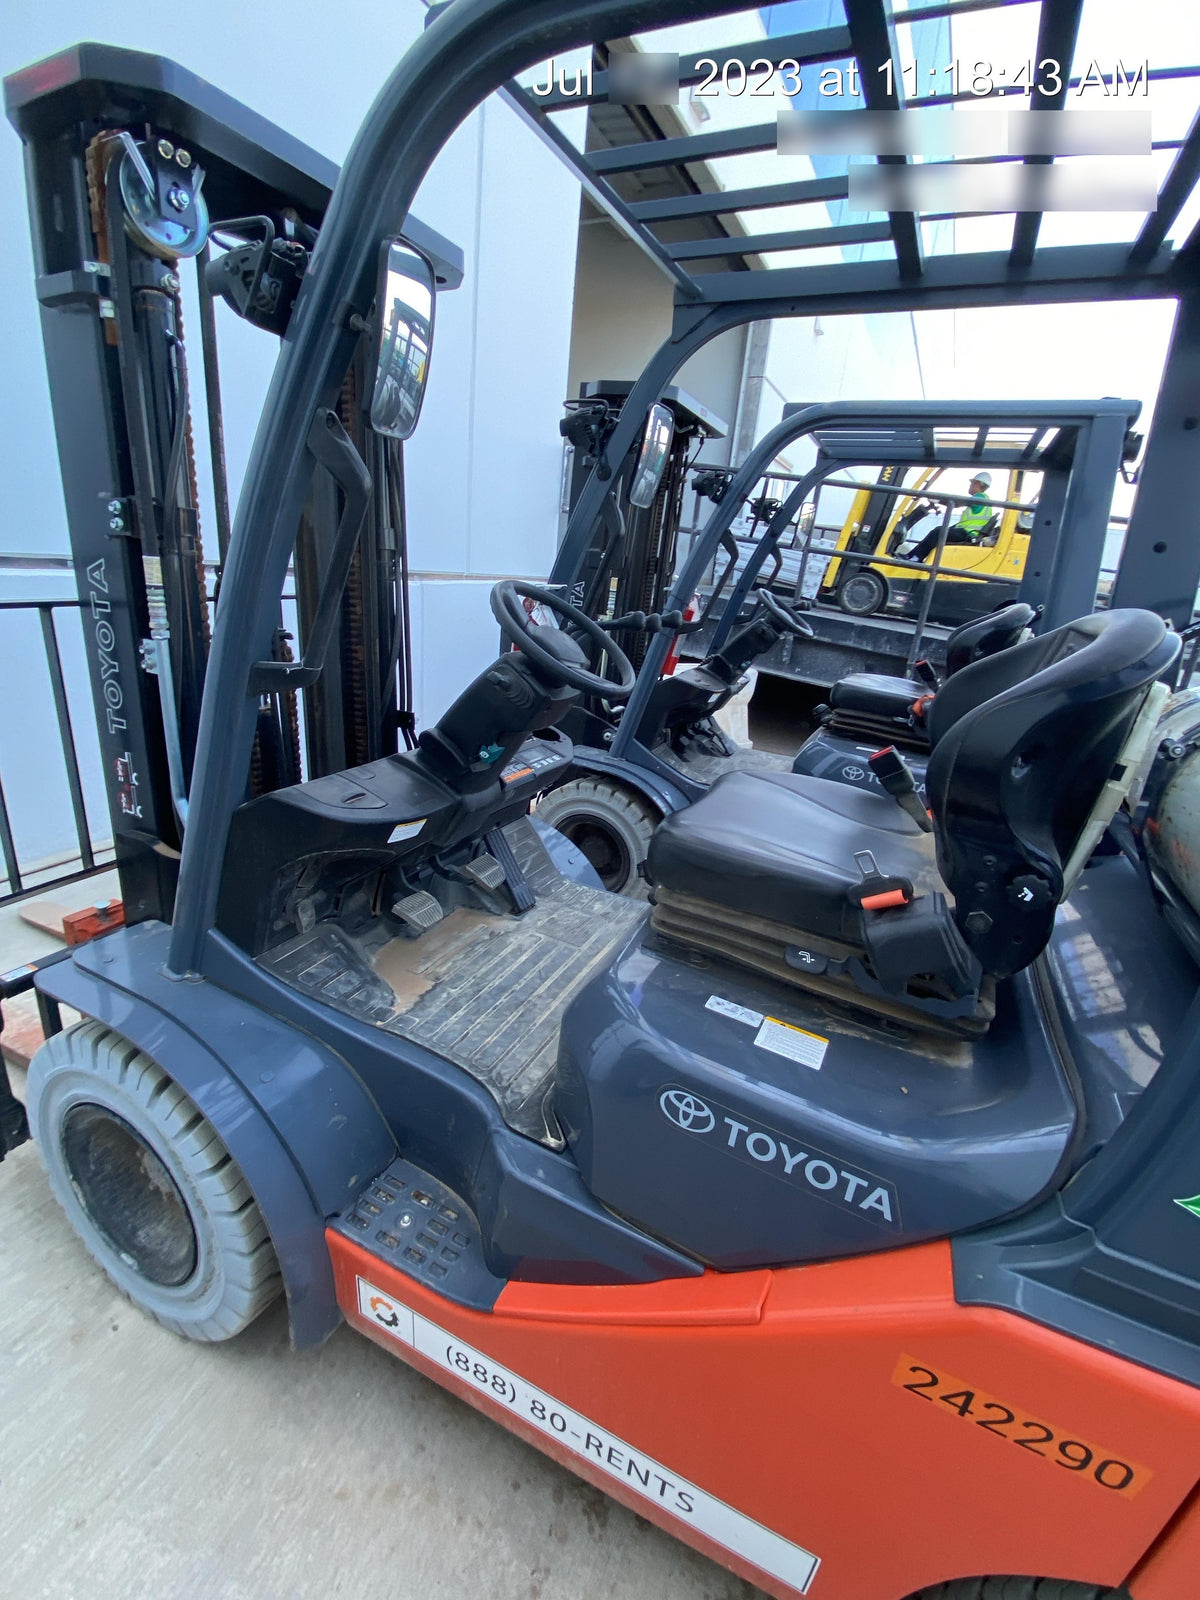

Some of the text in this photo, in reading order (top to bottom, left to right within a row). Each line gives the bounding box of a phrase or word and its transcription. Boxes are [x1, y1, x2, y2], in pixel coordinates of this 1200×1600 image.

[86, 557, 128, 735] TOYOTA
[723, 1116, 893, 1223] TOYOTA
[445, 1345, 696, 1514] (888) 80-RENTS
[902, 1365, 1135, 1490] 242290
